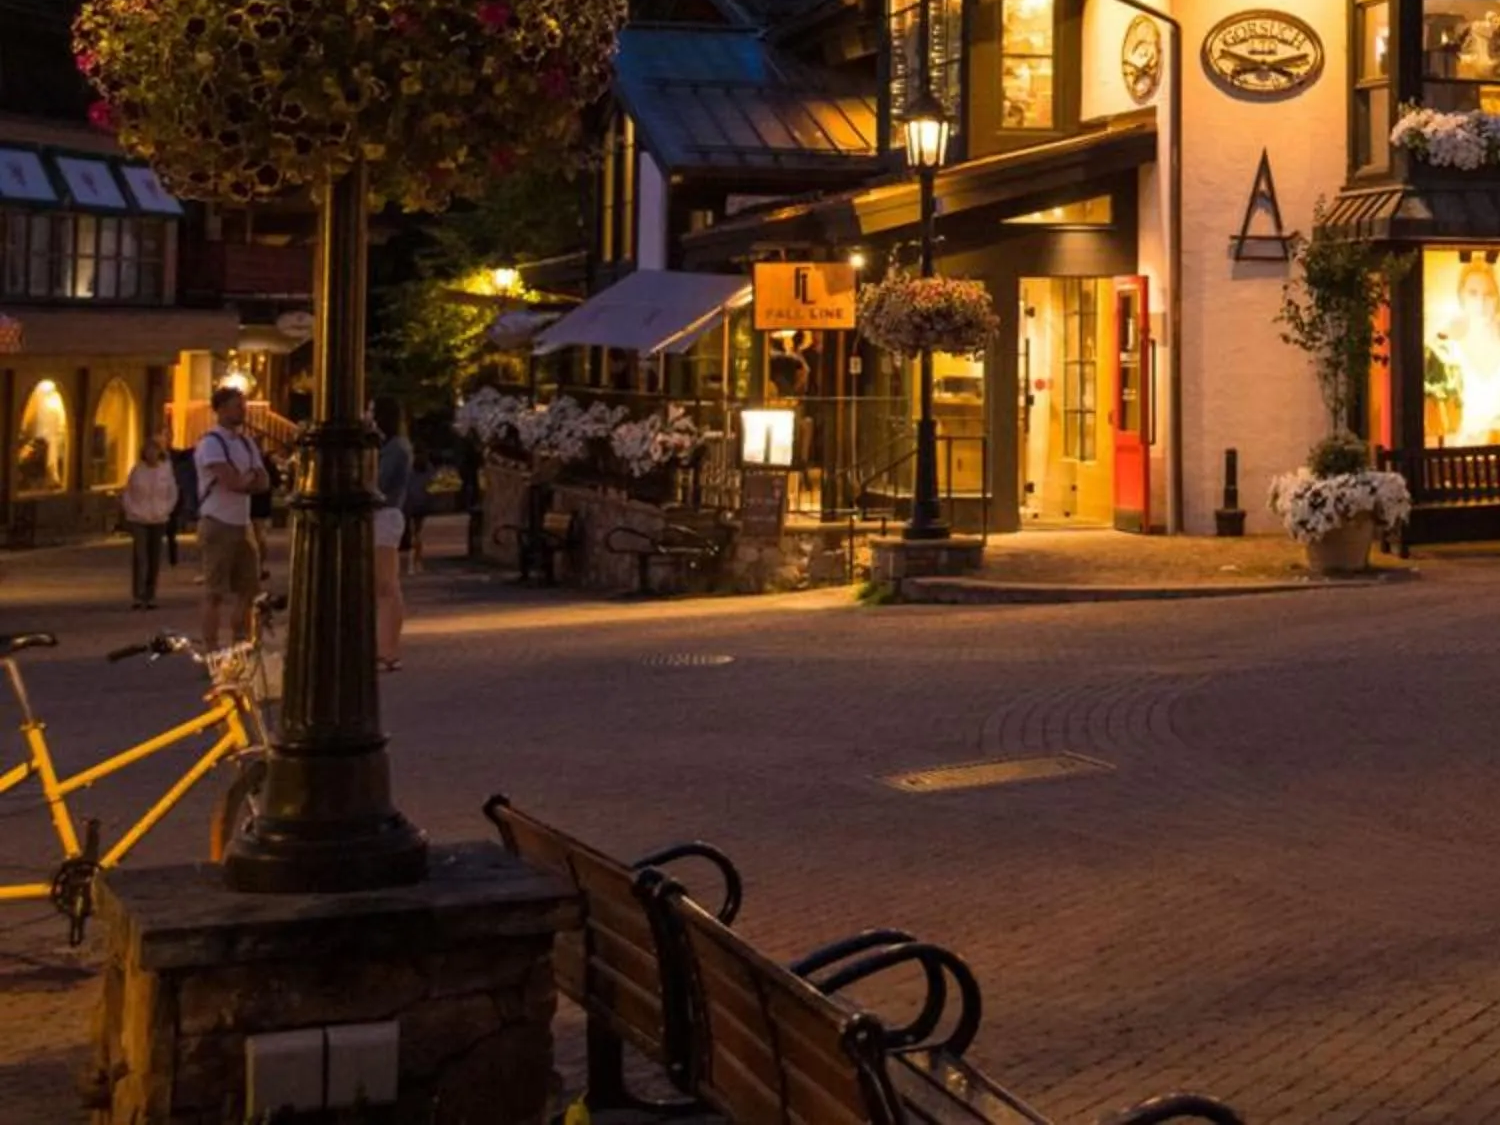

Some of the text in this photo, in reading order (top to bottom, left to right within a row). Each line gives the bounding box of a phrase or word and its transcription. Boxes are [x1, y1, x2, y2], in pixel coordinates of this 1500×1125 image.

[1221, 21, 1306, 51] GORSUCH
[765, 307, 843, 320] FALL LINE
